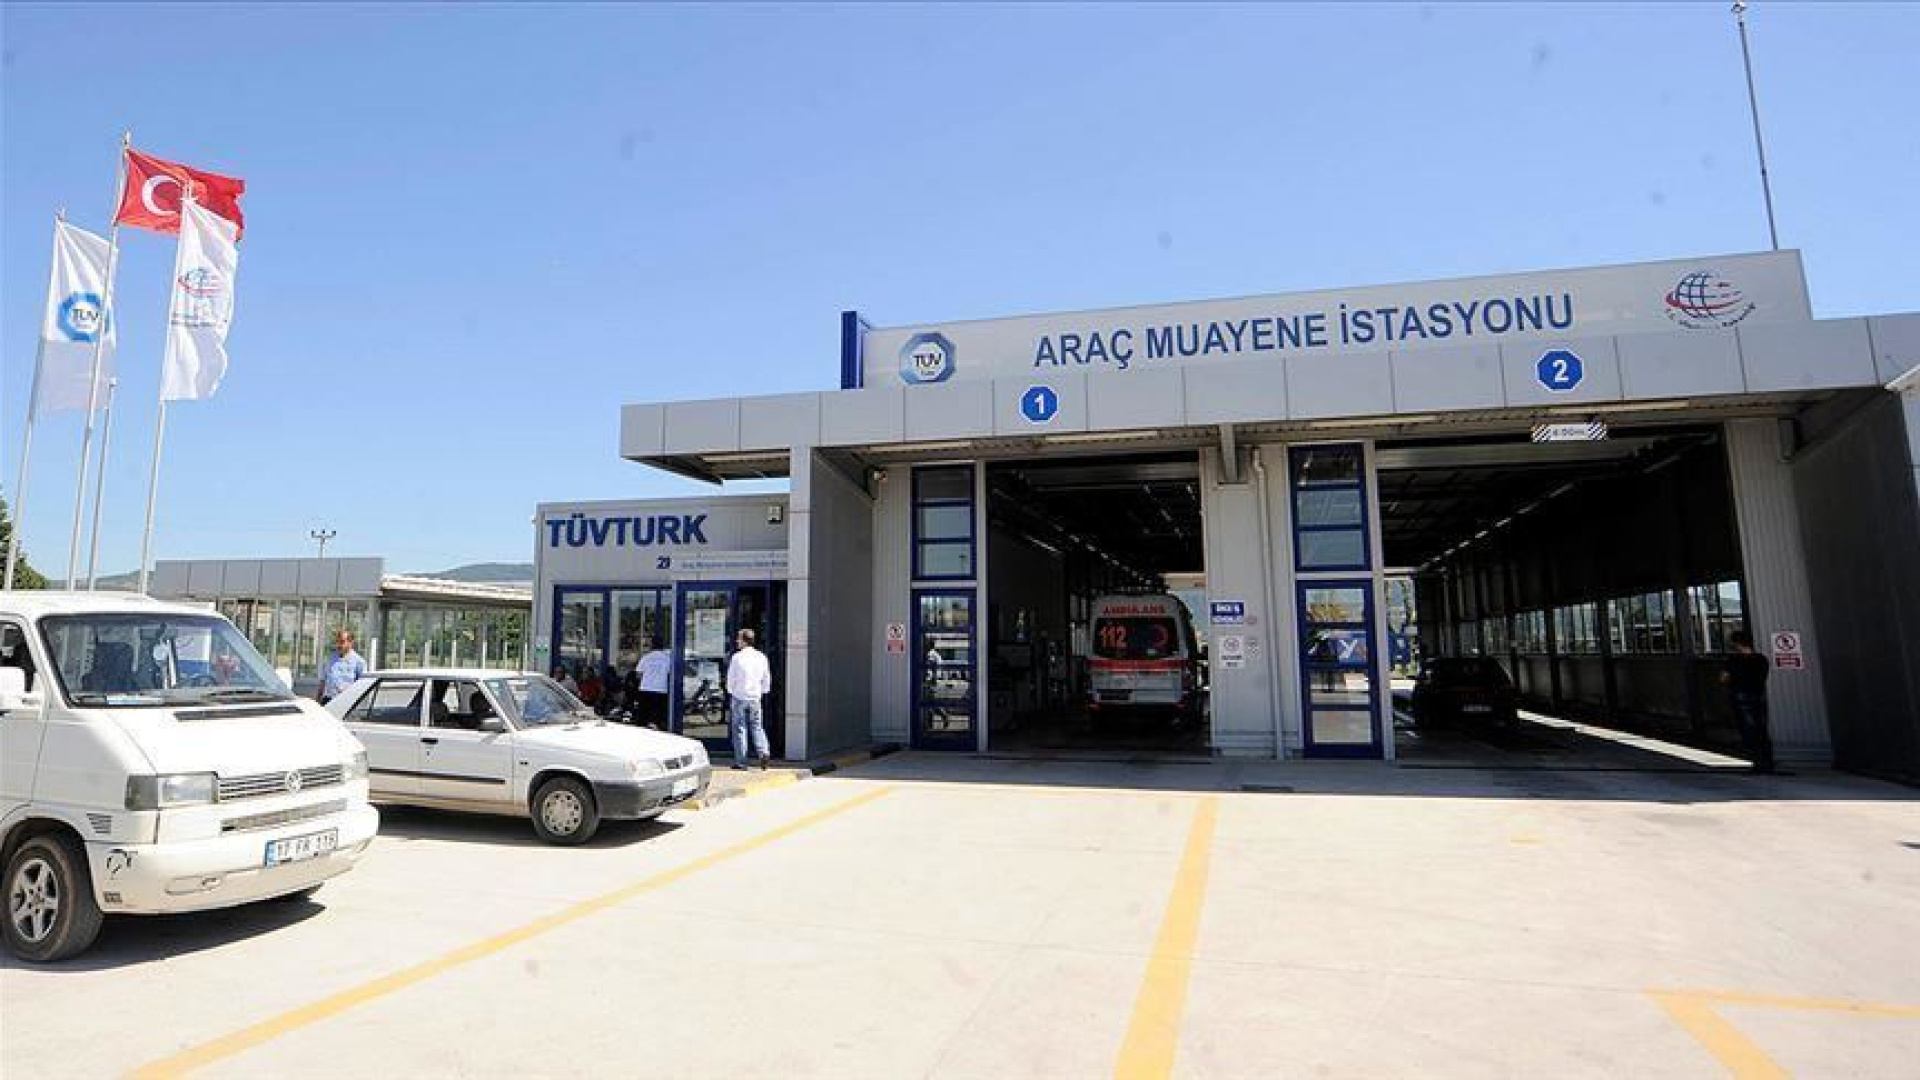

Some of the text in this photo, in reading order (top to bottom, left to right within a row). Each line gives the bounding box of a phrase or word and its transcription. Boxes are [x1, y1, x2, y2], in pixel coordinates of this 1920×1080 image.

[1034, 293, 1574, 370] ARAÇ MUAYENE İSTASYONU
[1552, 359, 1570, 383] 2
[1034, 393, 1045, 414] 1
[545, 513, 709, 548] TÜVTURK
[1102, 603, 1167, 616] AMBULANS
[1100, 625, 1127, 649] 112
